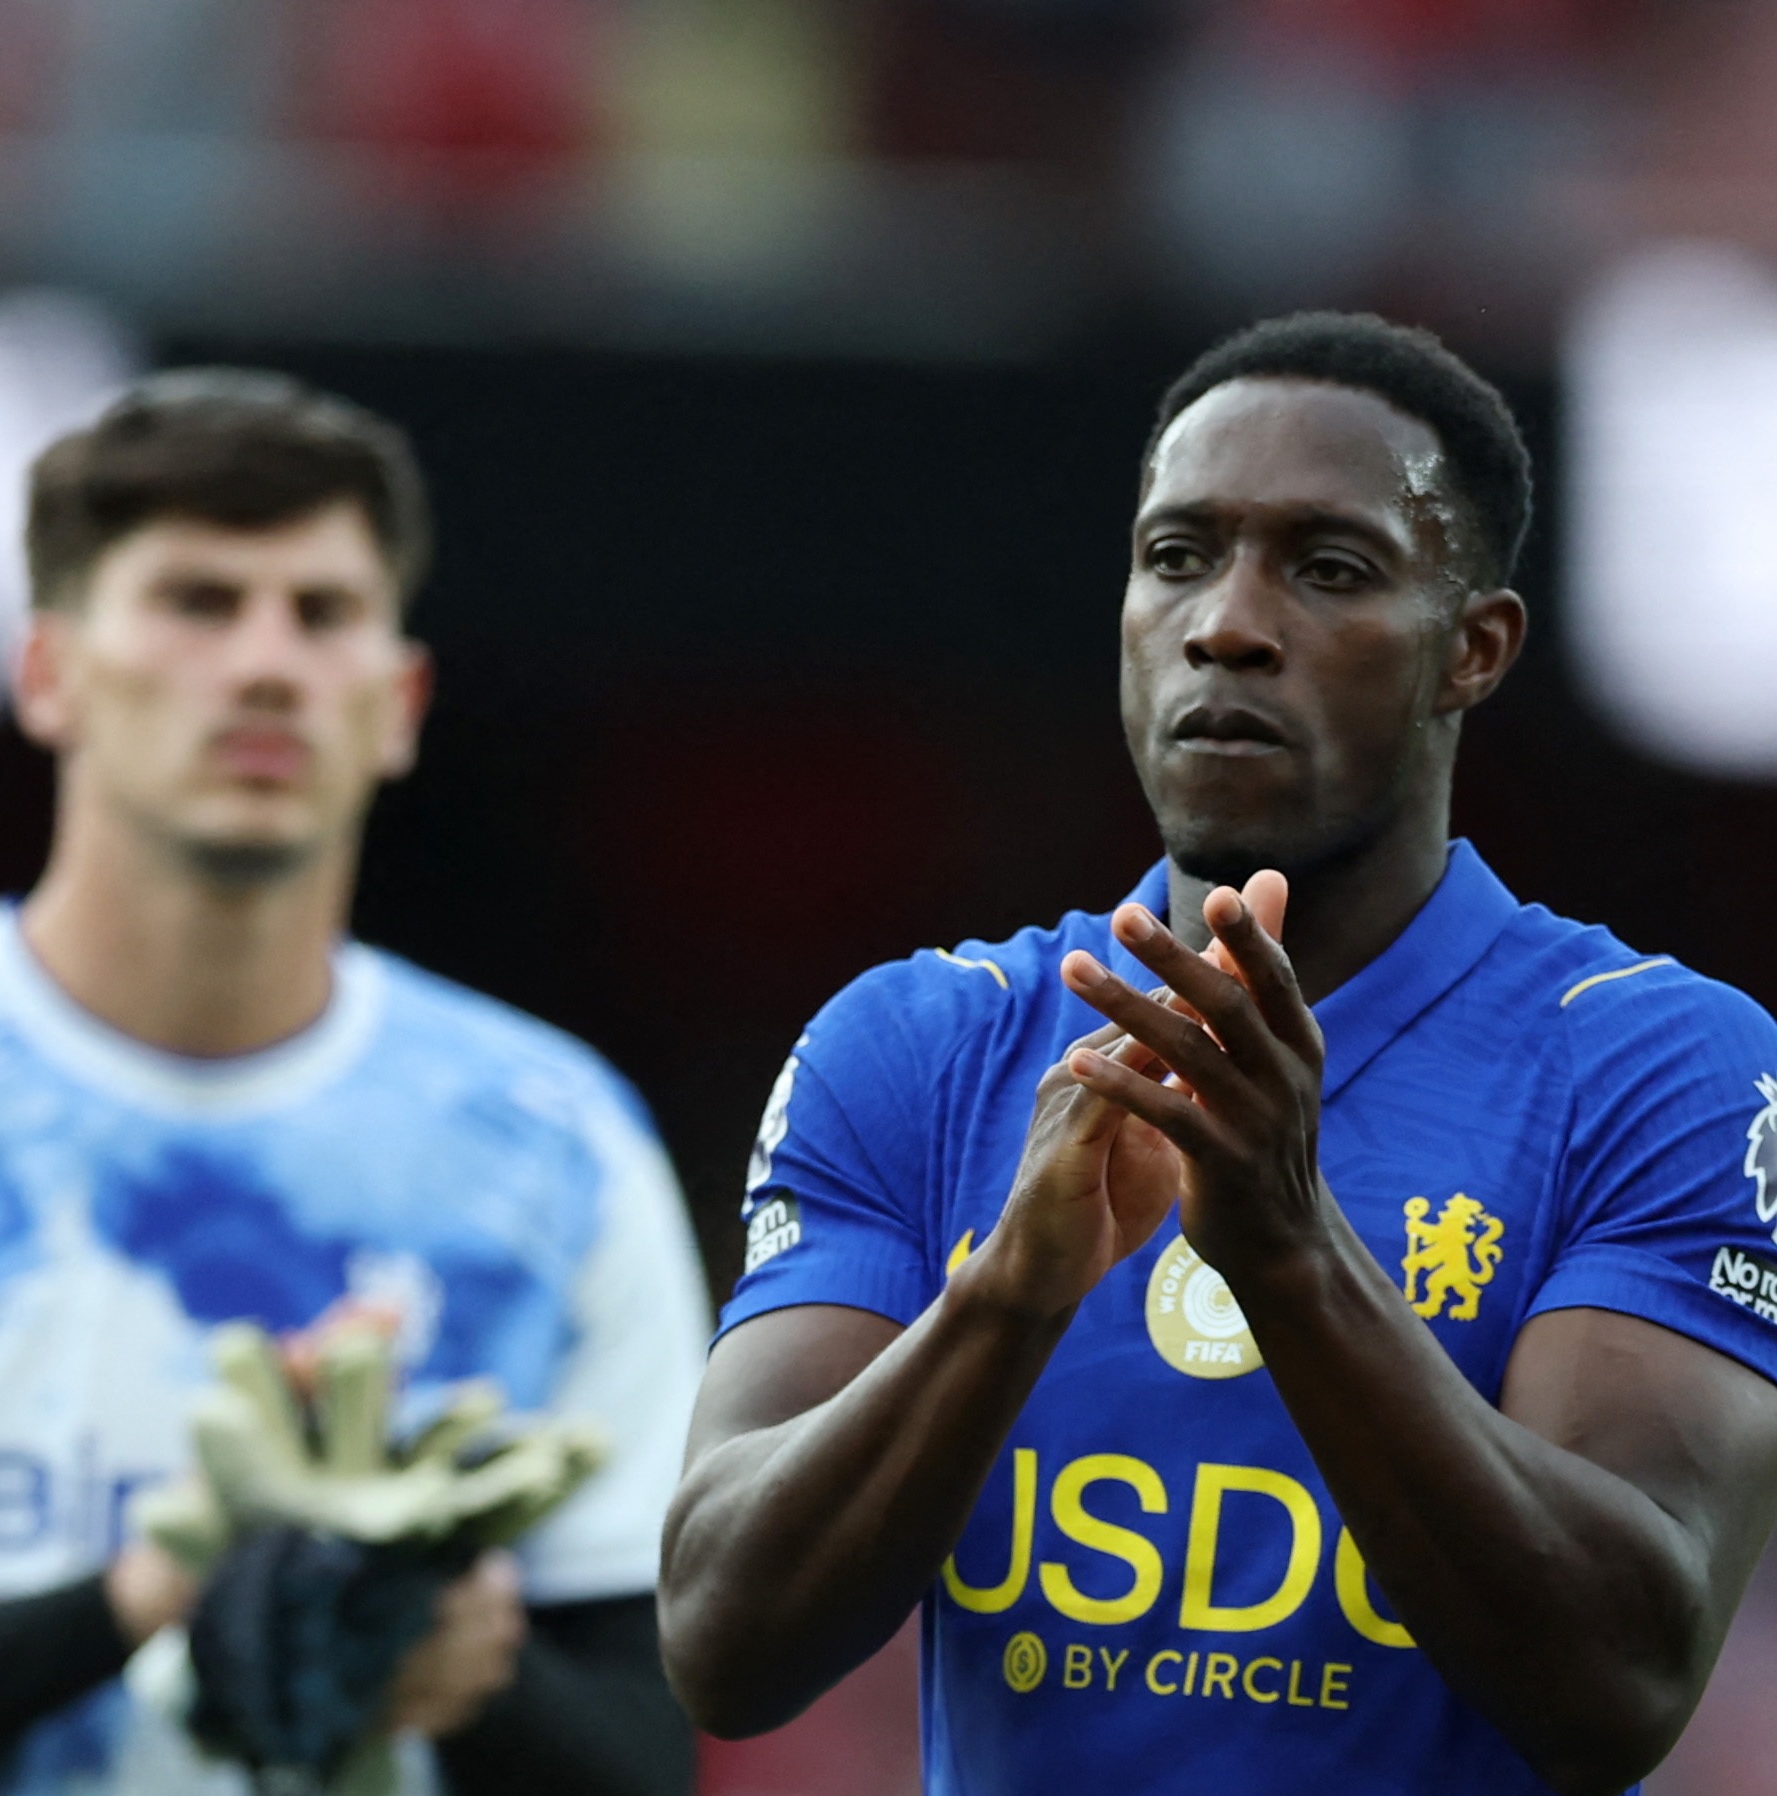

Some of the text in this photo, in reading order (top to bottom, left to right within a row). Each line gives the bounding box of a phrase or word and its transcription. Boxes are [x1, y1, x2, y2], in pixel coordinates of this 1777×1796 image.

[1711, 1246, 1760, 1290] No
[1184, 1340, 1243, 1364] FIFA
[1063, 1644, 1353, 1710] BY CIRCLE
